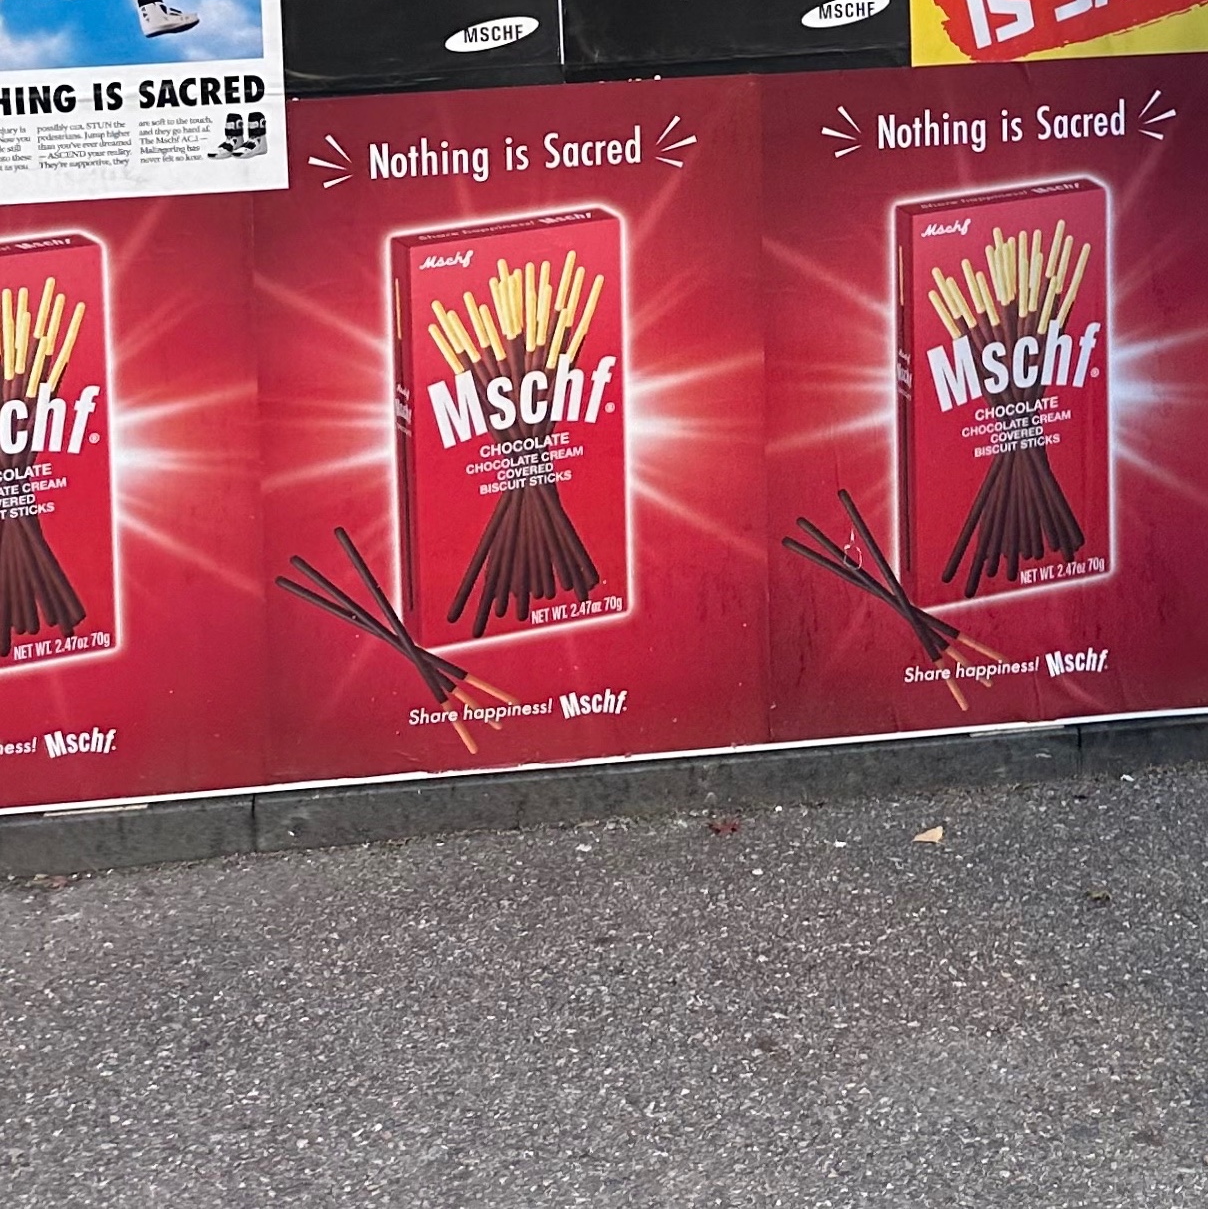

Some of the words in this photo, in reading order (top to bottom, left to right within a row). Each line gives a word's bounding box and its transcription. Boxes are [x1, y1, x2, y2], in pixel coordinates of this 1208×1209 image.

[819, 1, 876, 20] MSCHF
[464, 25, 524, 43] MSCHF
[0, 84, 76, 116] HING
[93, 82, 123, 111] IS
[139, 75, 265, 109] SACRED
[878, 109, 987, 152] Nothing
[1001, 109, 1023, 142] is
[1036, 99, 1125, 139] Sacred
[369, 137, 489, 183] Nothing
[505, 137, 529, 171] is
[544, 125, 642, 168] Sacred
[921, 218, 972, 238] Mschf
[419, 250, 474, 270] Mschf
[927, 320, 1101, 413] Mschf
[427, 353, 617, 449] Mschf
[974, 396, 1059, 421] CHOCOLATE
[0, 382, 100, 454] chf
[961, 417, 1030, 438] CHOCOLATE
[1032, 409, 1072, 426] CREAM
[479, 432, 570, 459] CHOCOLATE
[974, 441, 1018, 458] BISCUIT
[1020, 433, 1061, 450] STICKS
[990, 425, 1044, 444] COVERED
[465, 455, 538, 475] CHOCOLATE
[541, 446, 584, 462] CREAM
[497, 462, 554, 481] COVERED
[22, 477, 67, 493] CREAM
[479, 479, 526, 495] BISCUIT
[530, 470, 573, 487] STICKS
[10, 502, 55, 519] STICKS
[1020, 569, 1037, 585] NET
[1057, 562, 1086, 578] 2.47oz
[1088, 557, 1105, 573] 70g
[531, 608, 550, 625] NET
[570, 598, 602, 618] 2.47oz
[604, 596, 623, 612] 70g
[14, 645, 32, 660] NET
[55, 635, 89, 653] 2.47oz
[91, 631, 111, 647] 70g
[904, 665, 951, 683] Share
[955, 656, 1039, 681] happiness!
[1045, 647, 1109, 678] Mschf
[409, 709, 458, 726] Share
[463, 698, 553, 724] happiness!
[559, 688, 628, 719] Mschf
